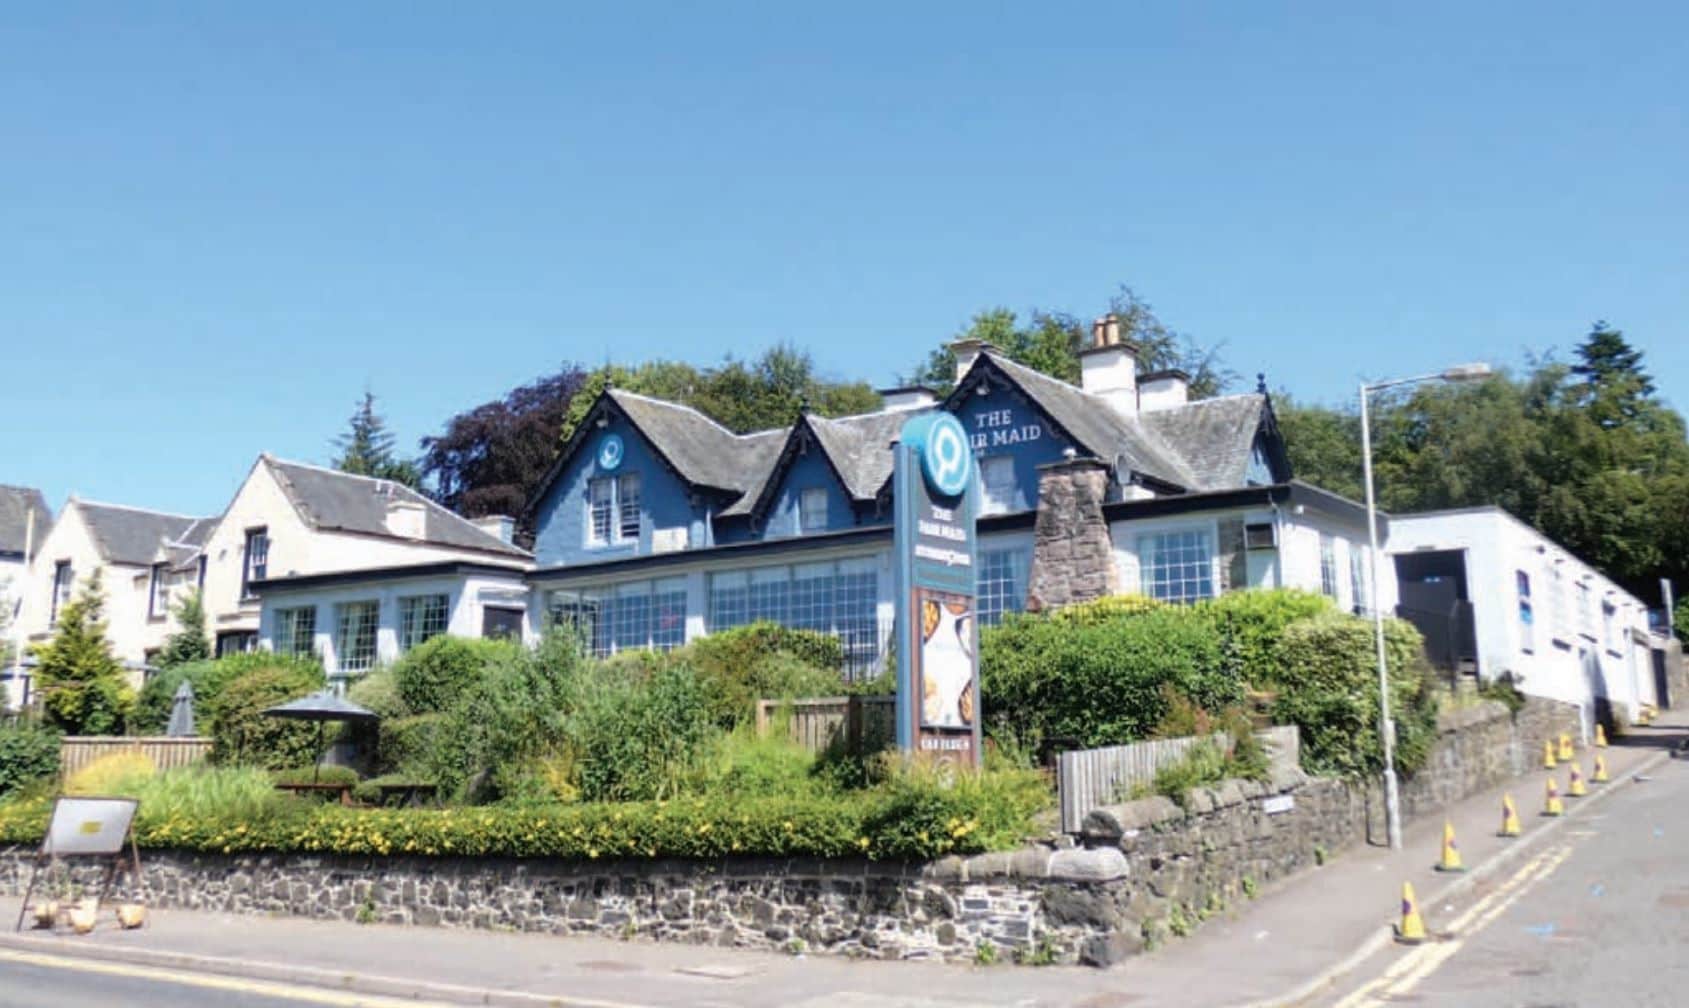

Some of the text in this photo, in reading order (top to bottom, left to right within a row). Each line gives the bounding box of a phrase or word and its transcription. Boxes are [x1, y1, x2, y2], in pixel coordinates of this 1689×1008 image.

[976, 410, 1011, 428] THE
[970, 425, 1041, 448] IR MAID
